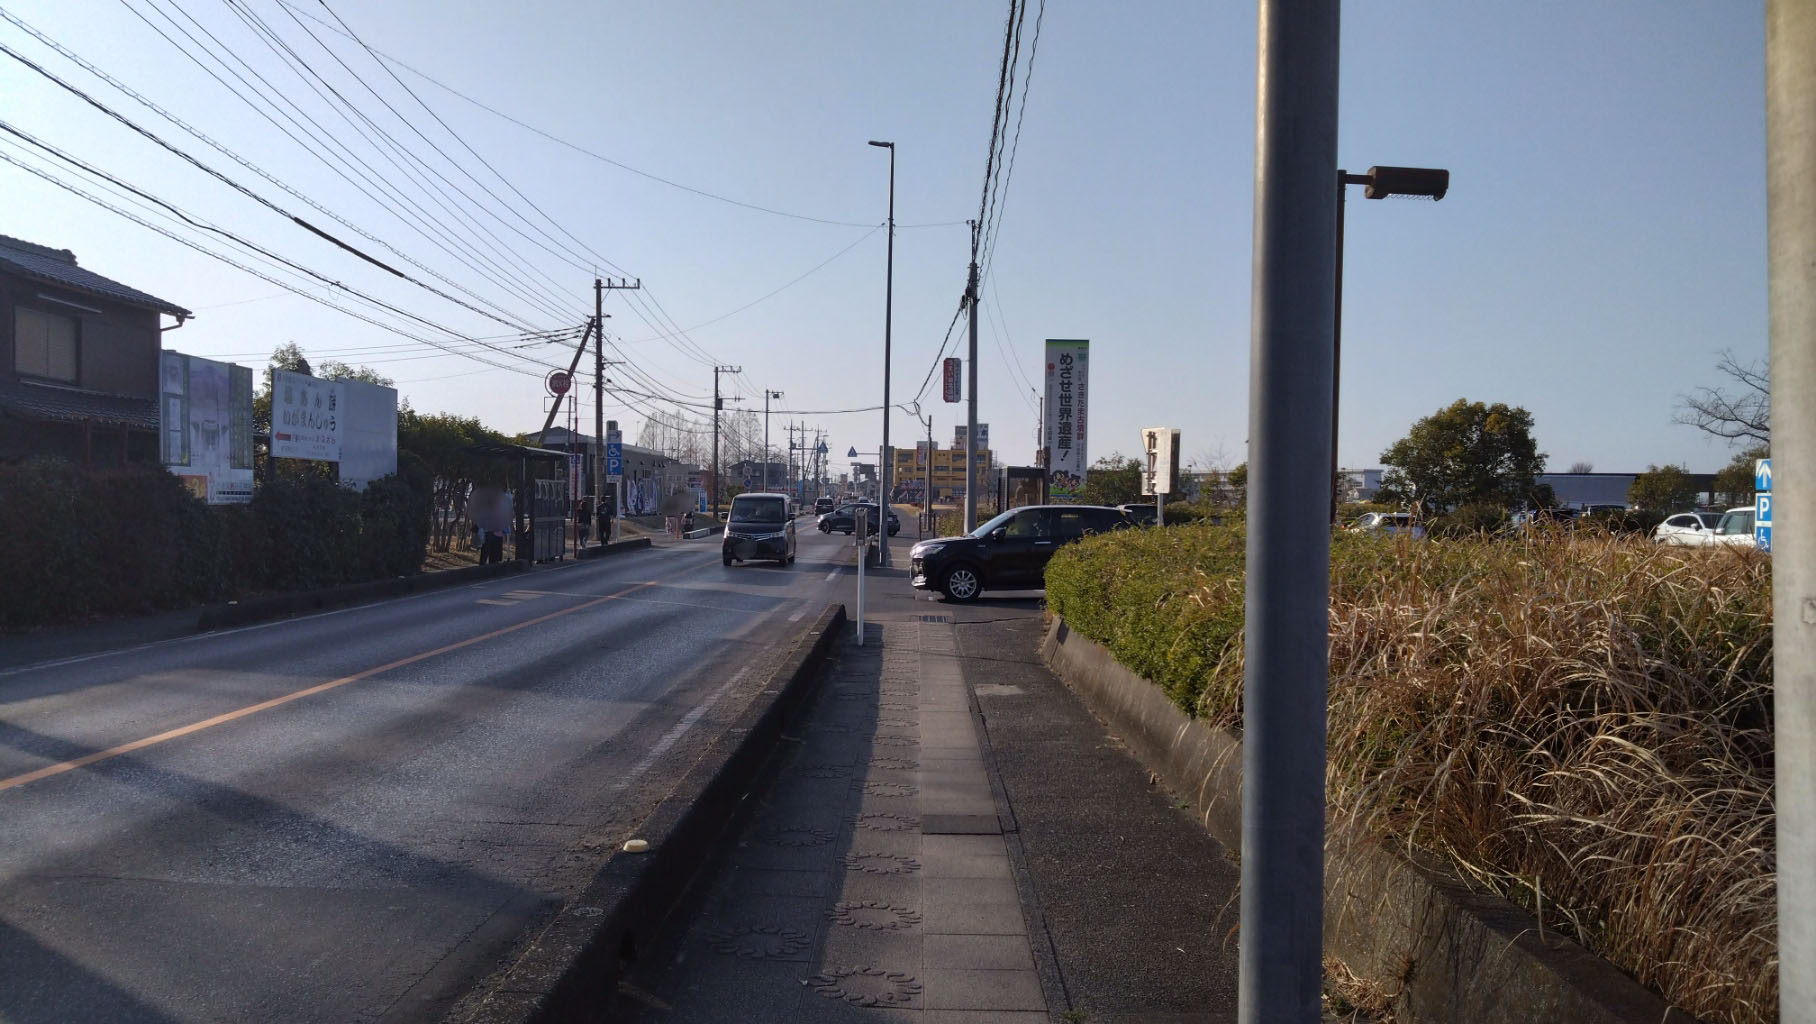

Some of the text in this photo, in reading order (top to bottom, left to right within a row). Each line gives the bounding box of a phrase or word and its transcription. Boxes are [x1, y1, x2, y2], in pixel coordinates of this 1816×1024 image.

[1077, 383, 1086, 440] さきたま古墳群
[609, 459, 619, 473] P
[1760, 497, 1769, 519] P
